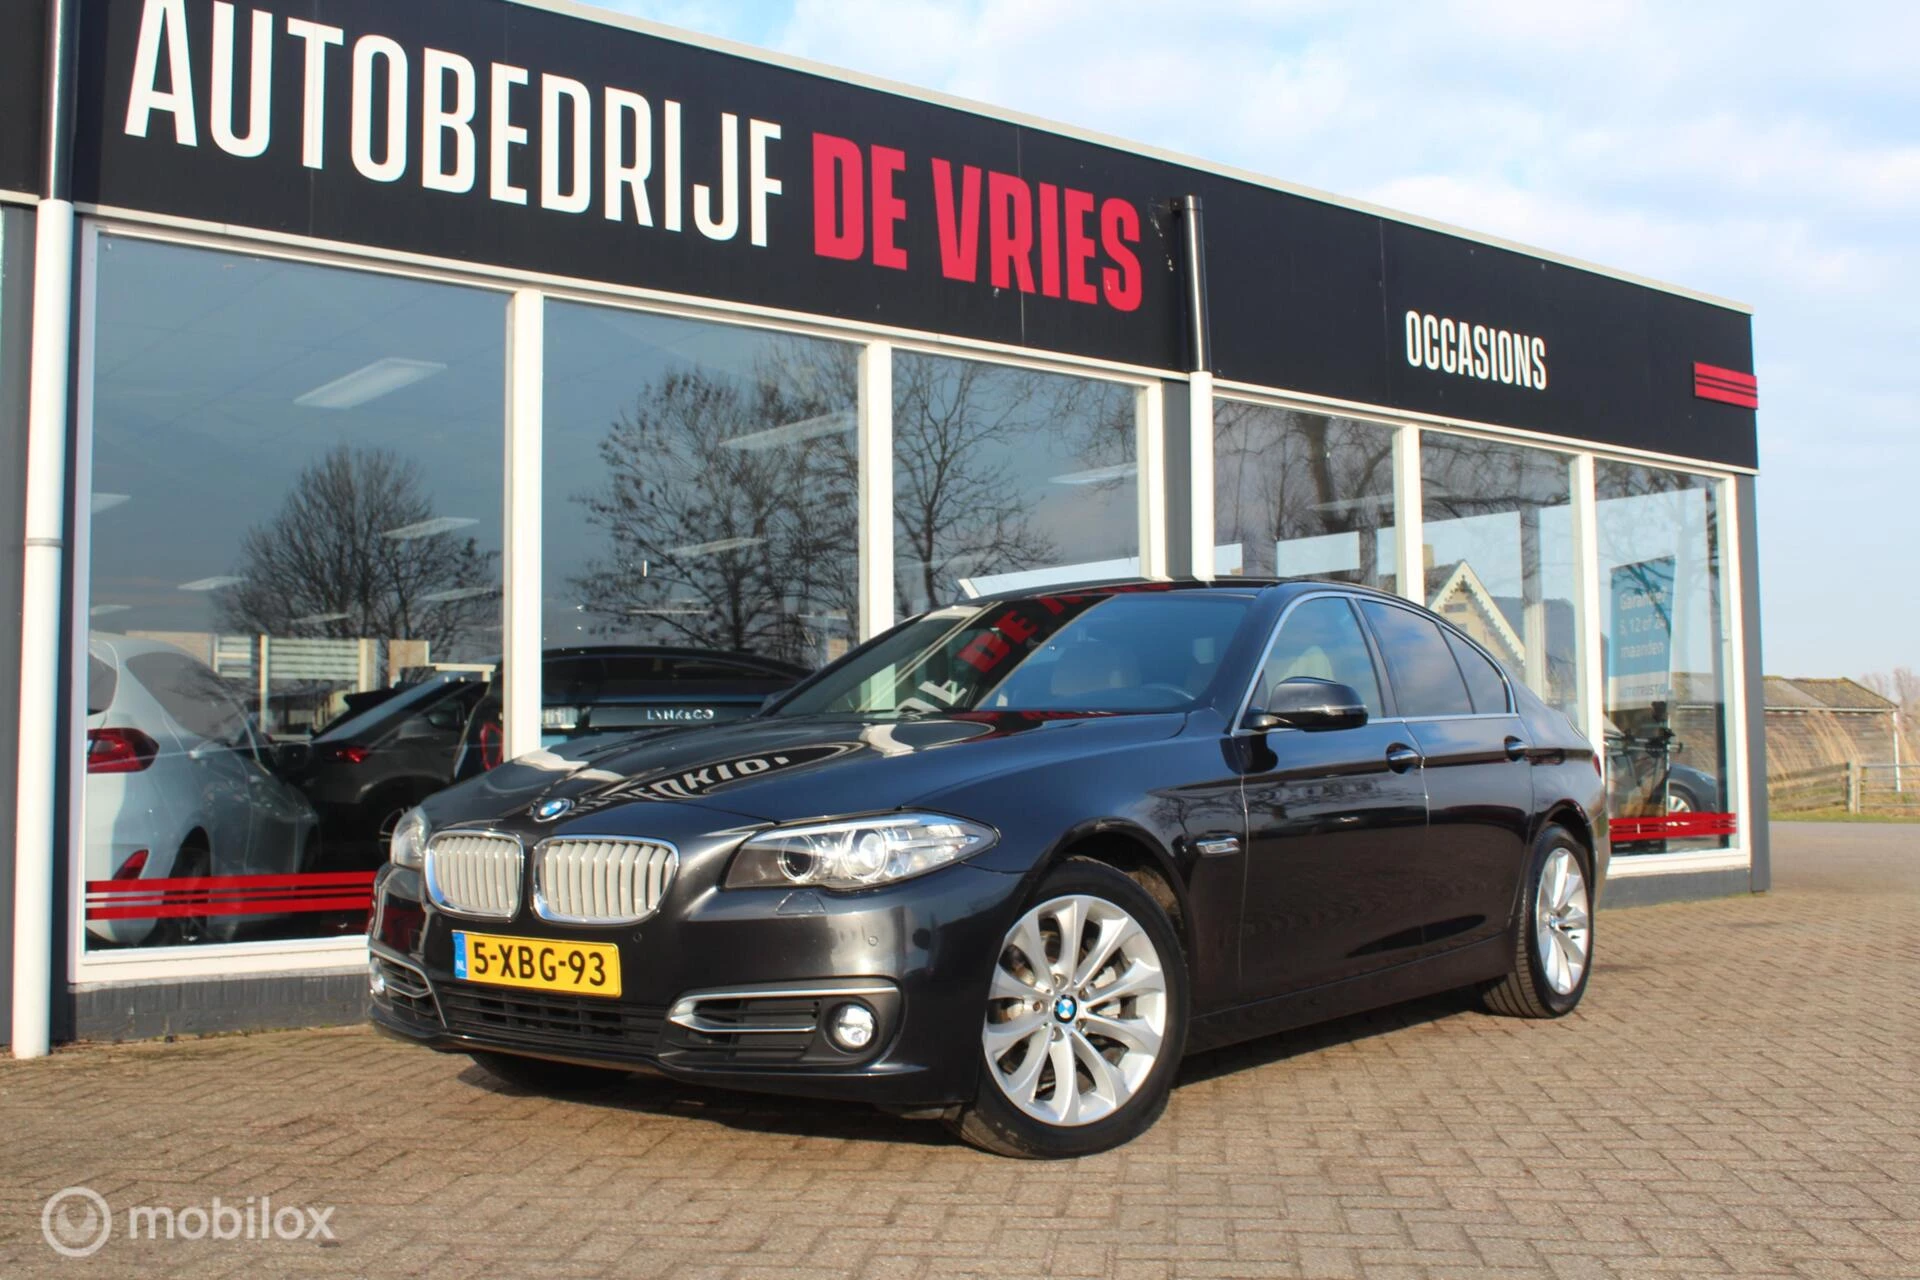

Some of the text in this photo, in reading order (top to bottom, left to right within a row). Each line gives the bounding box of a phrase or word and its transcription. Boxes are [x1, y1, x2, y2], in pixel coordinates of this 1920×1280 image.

[125, 0, 1143, 312] AUTOBEDRIJF DE VRIES
[1405, 310, 1547, 391] OCCASIONS
[473, 941, 606, 987] 5-XBG-93
